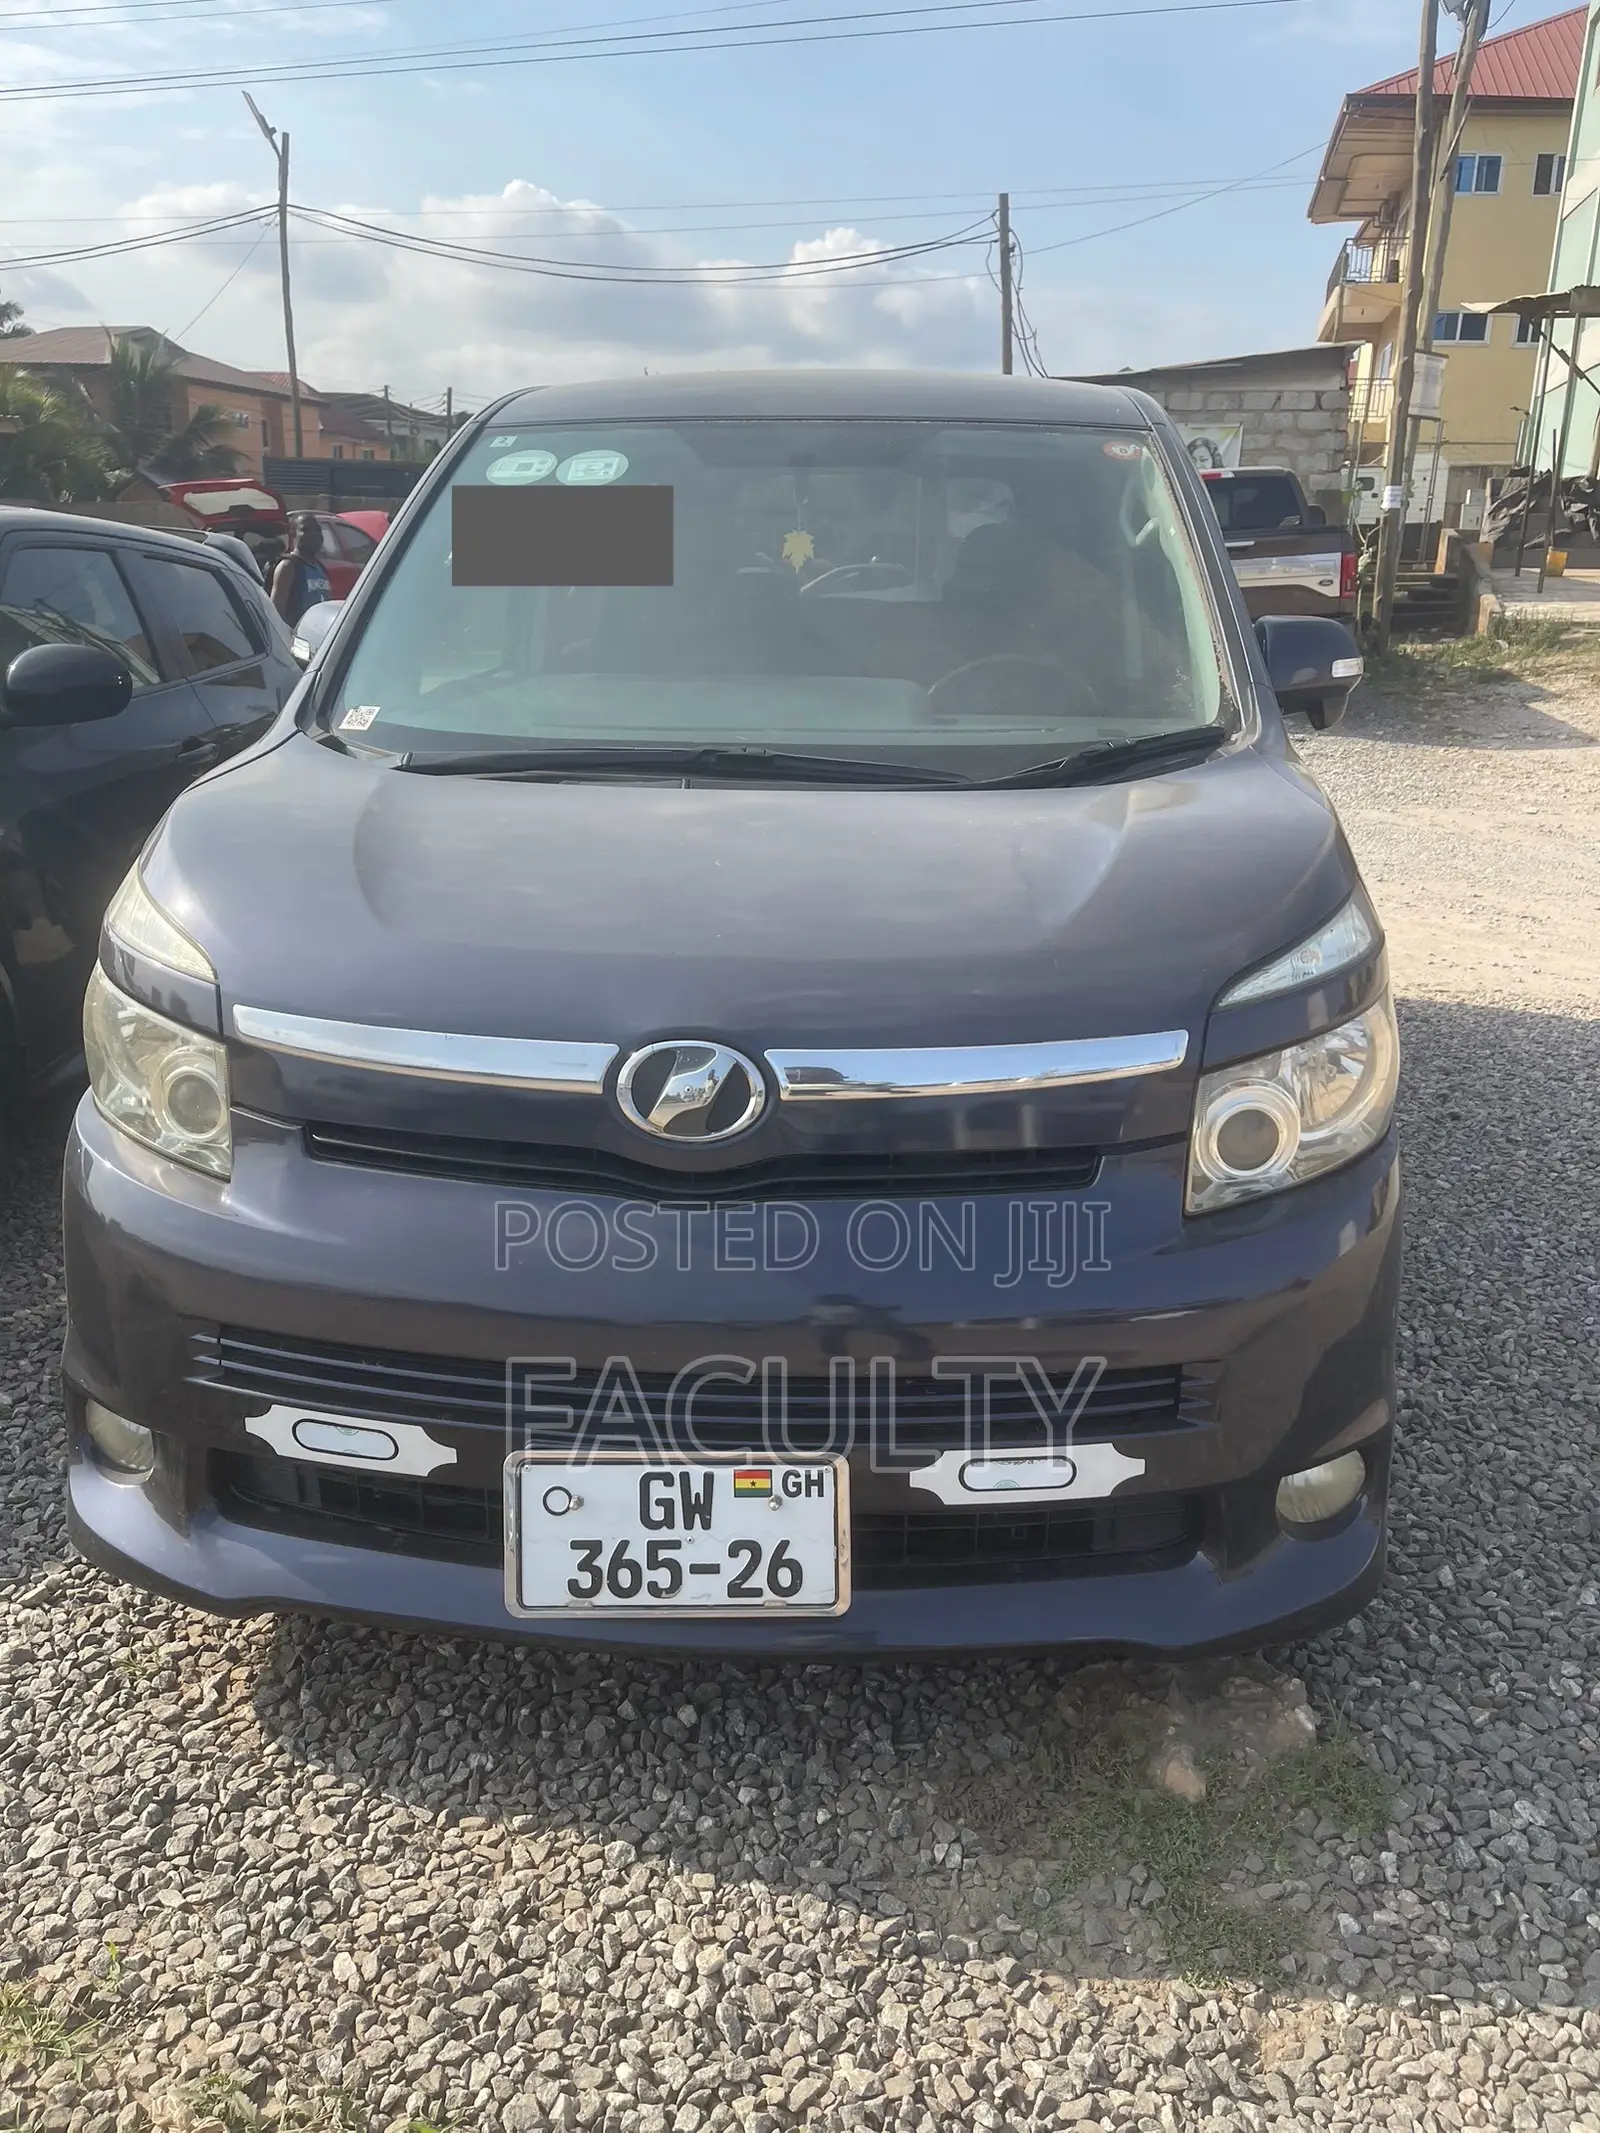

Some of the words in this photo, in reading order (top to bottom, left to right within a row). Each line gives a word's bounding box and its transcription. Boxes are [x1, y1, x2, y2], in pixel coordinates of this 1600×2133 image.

[638, 1470, 715, 1531] GW
[781, 1470, 825, 1498] GH
[566, 1539, 804, 1600] 365-26
